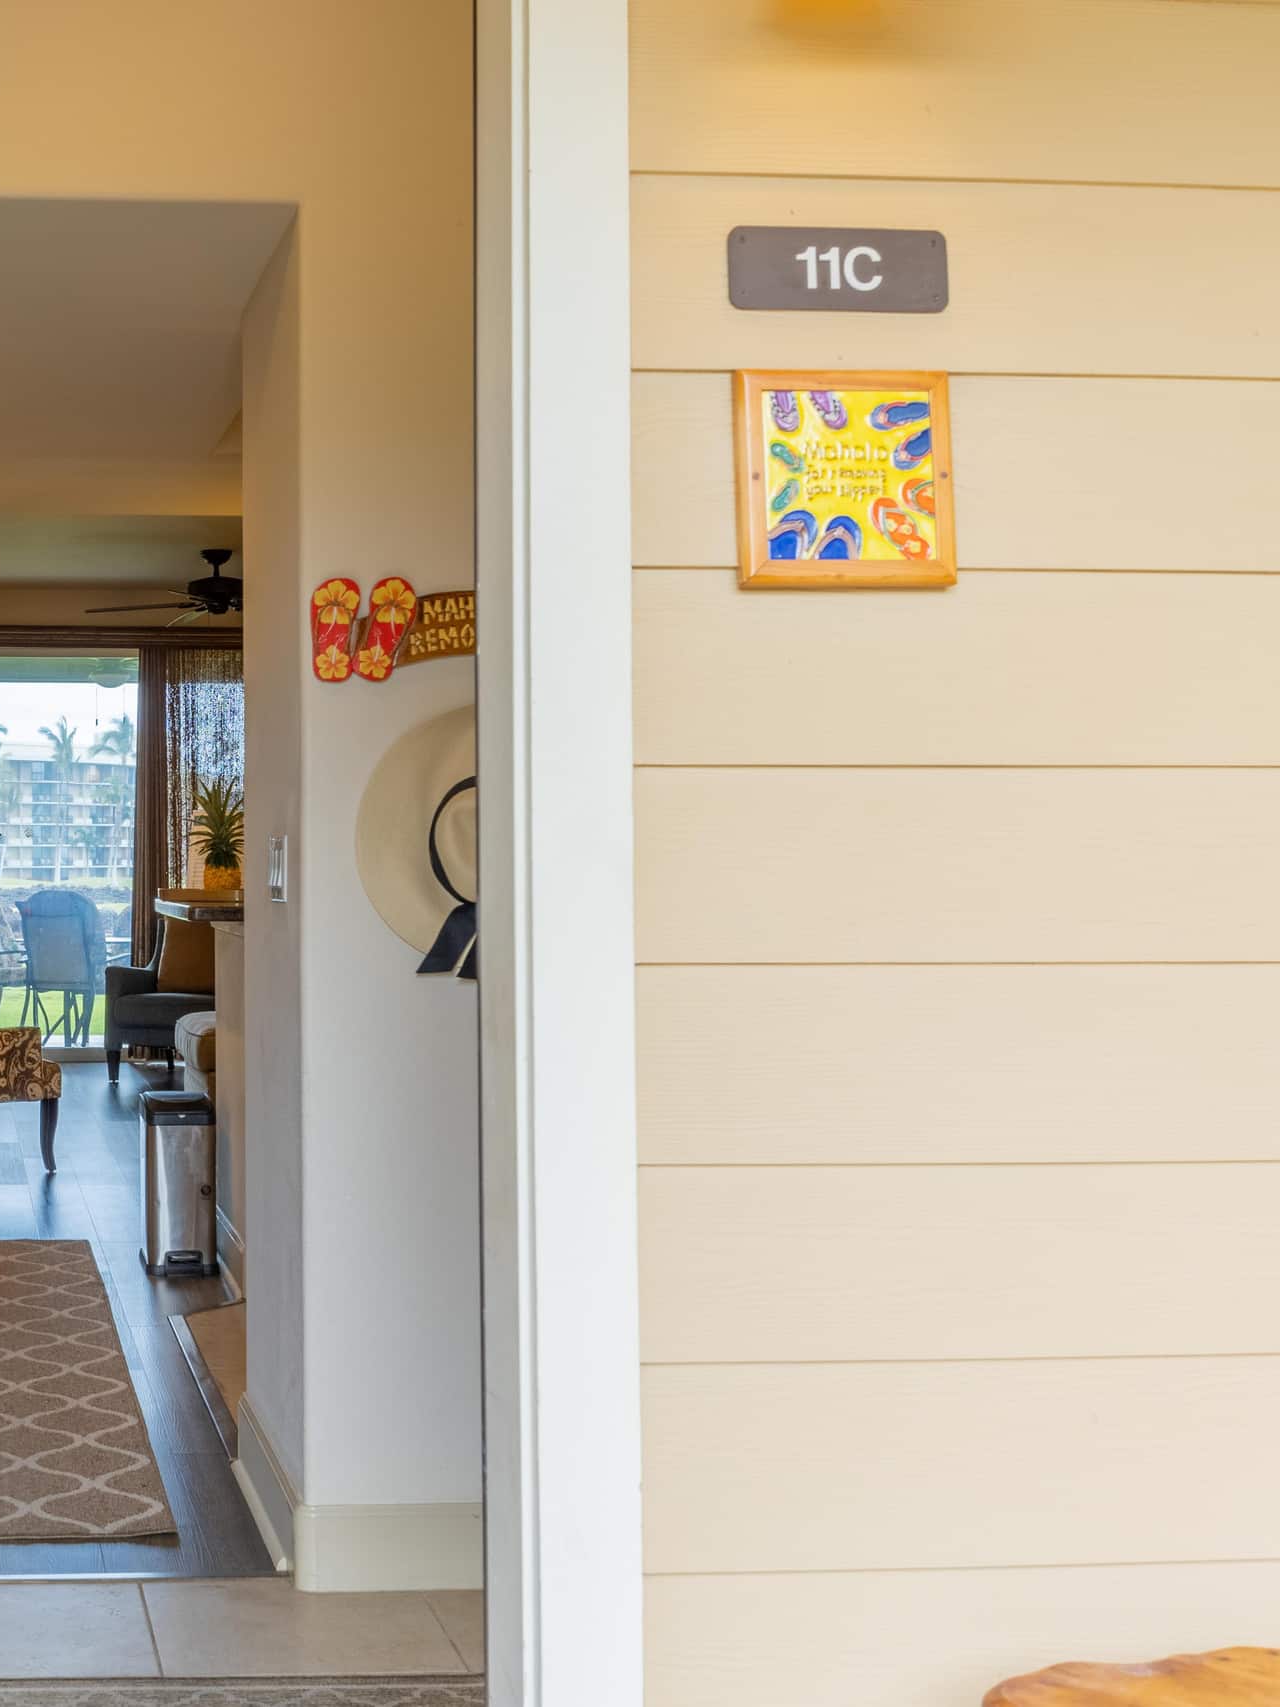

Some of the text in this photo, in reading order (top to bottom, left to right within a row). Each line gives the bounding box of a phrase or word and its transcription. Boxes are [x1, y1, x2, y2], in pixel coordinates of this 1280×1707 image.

[795, 246, 883, 291] 11C
[800, 440, 888, 462] Mahalo
[410, 624, 475, 655] REMO
